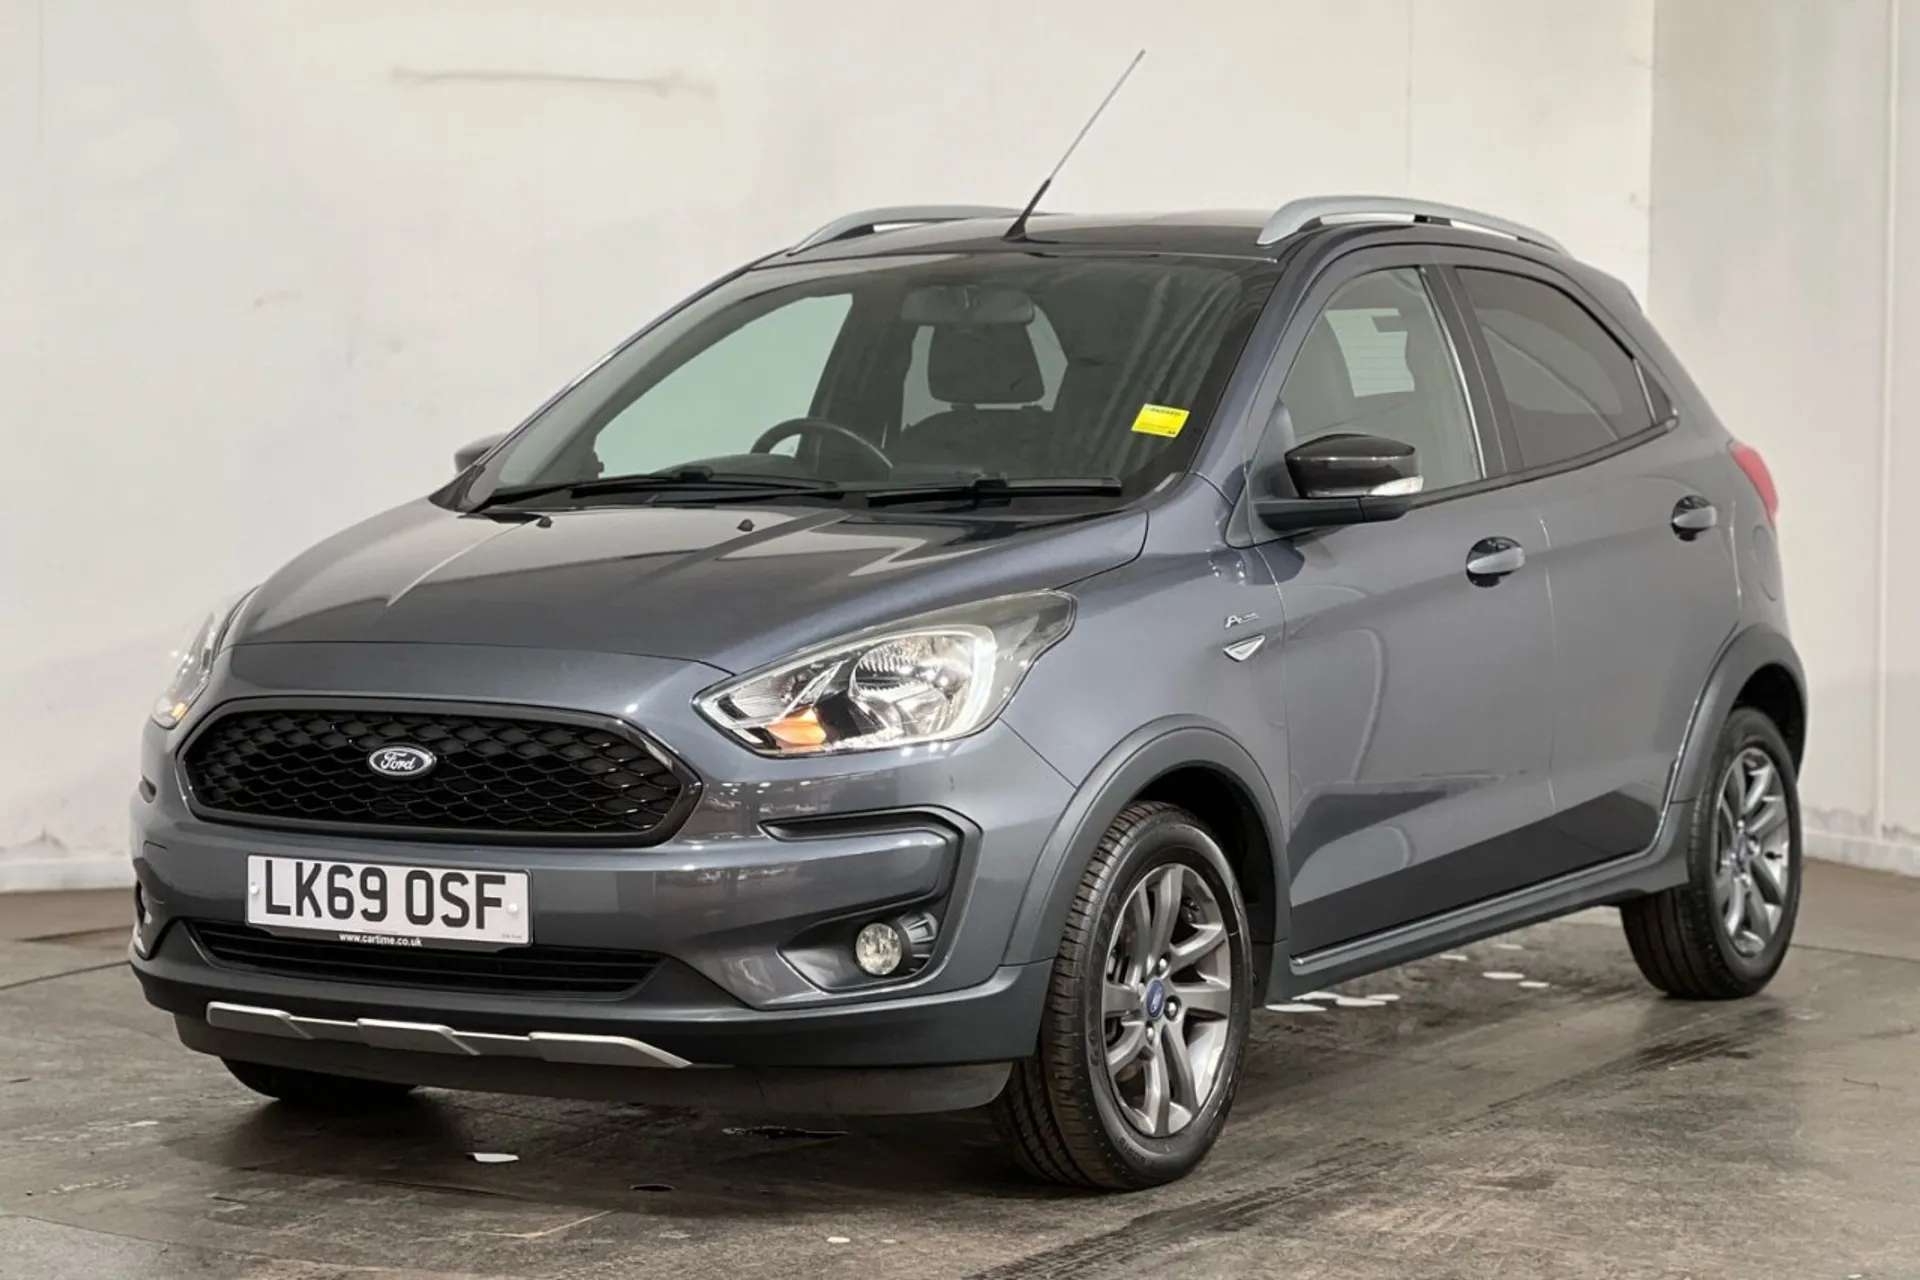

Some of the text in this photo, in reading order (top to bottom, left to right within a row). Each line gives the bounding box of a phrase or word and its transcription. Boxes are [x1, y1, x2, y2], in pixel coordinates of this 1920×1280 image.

[381, 751, 416, 770] Ford
[265, 859, 506, 930] LK69 OSF
[338, 932, 423, 947] www.cartime.co.uk
